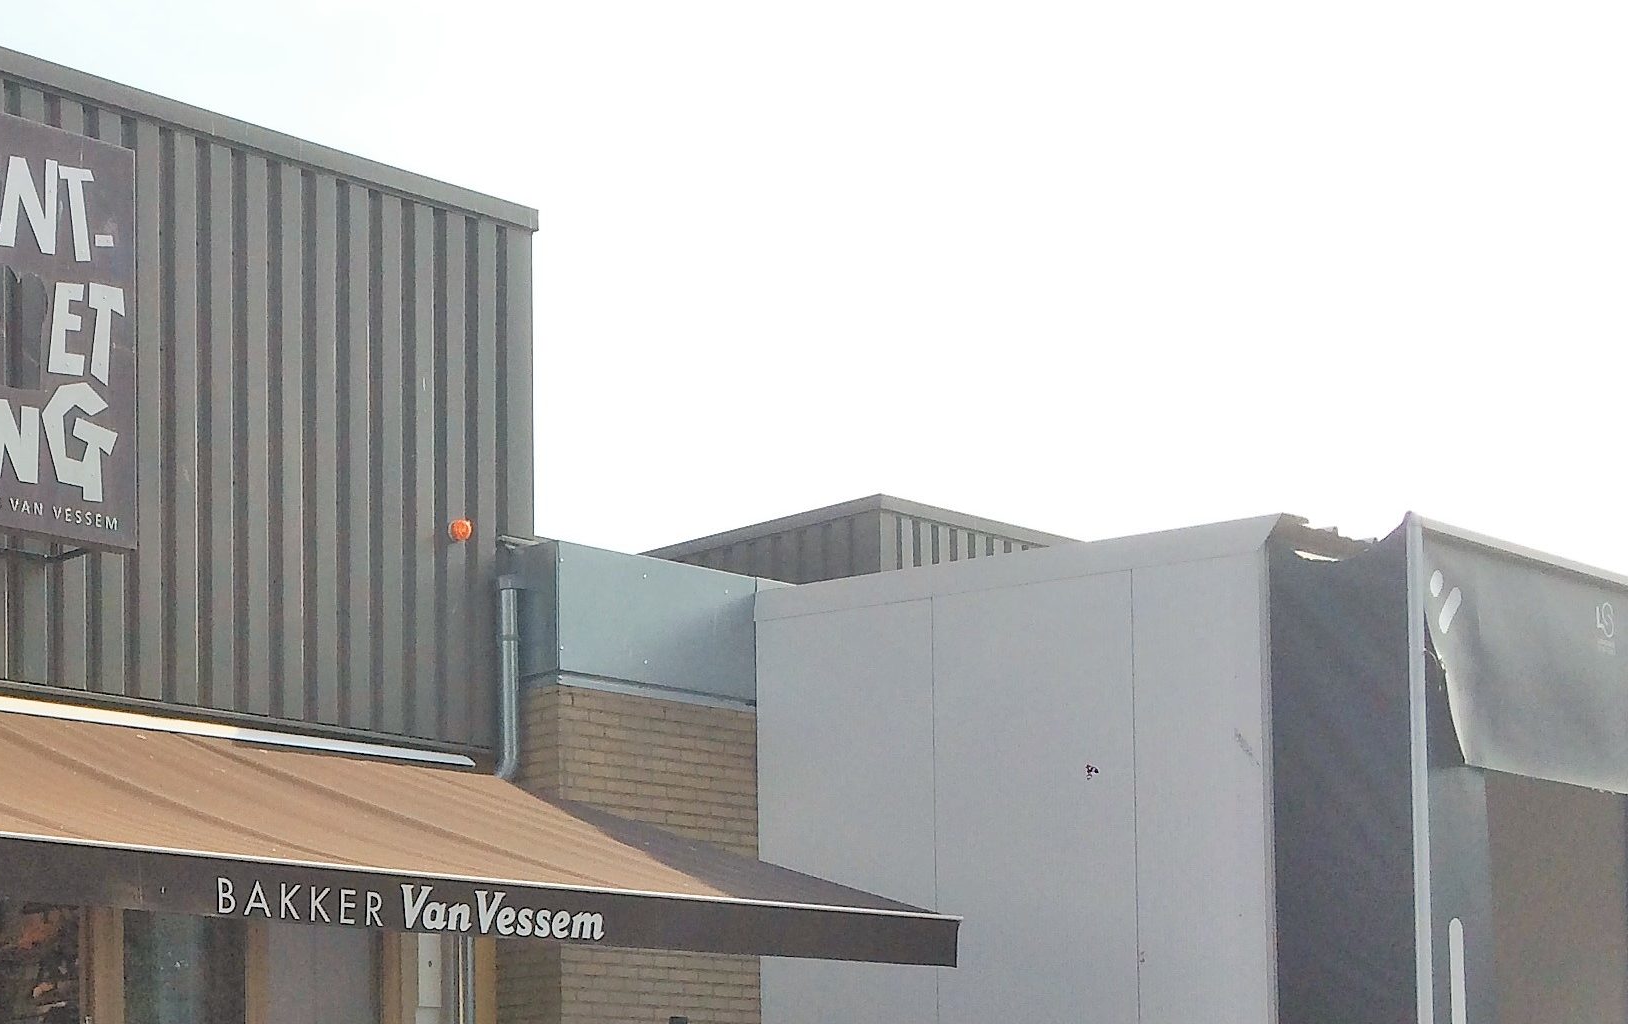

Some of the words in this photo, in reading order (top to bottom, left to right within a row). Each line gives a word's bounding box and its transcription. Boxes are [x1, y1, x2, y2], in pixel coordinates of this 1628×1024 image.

[9, 497, 44, 517] VAN
[52, 505, 119, 532] VESSEM
[216, 877, 385, 928] BAKKER
